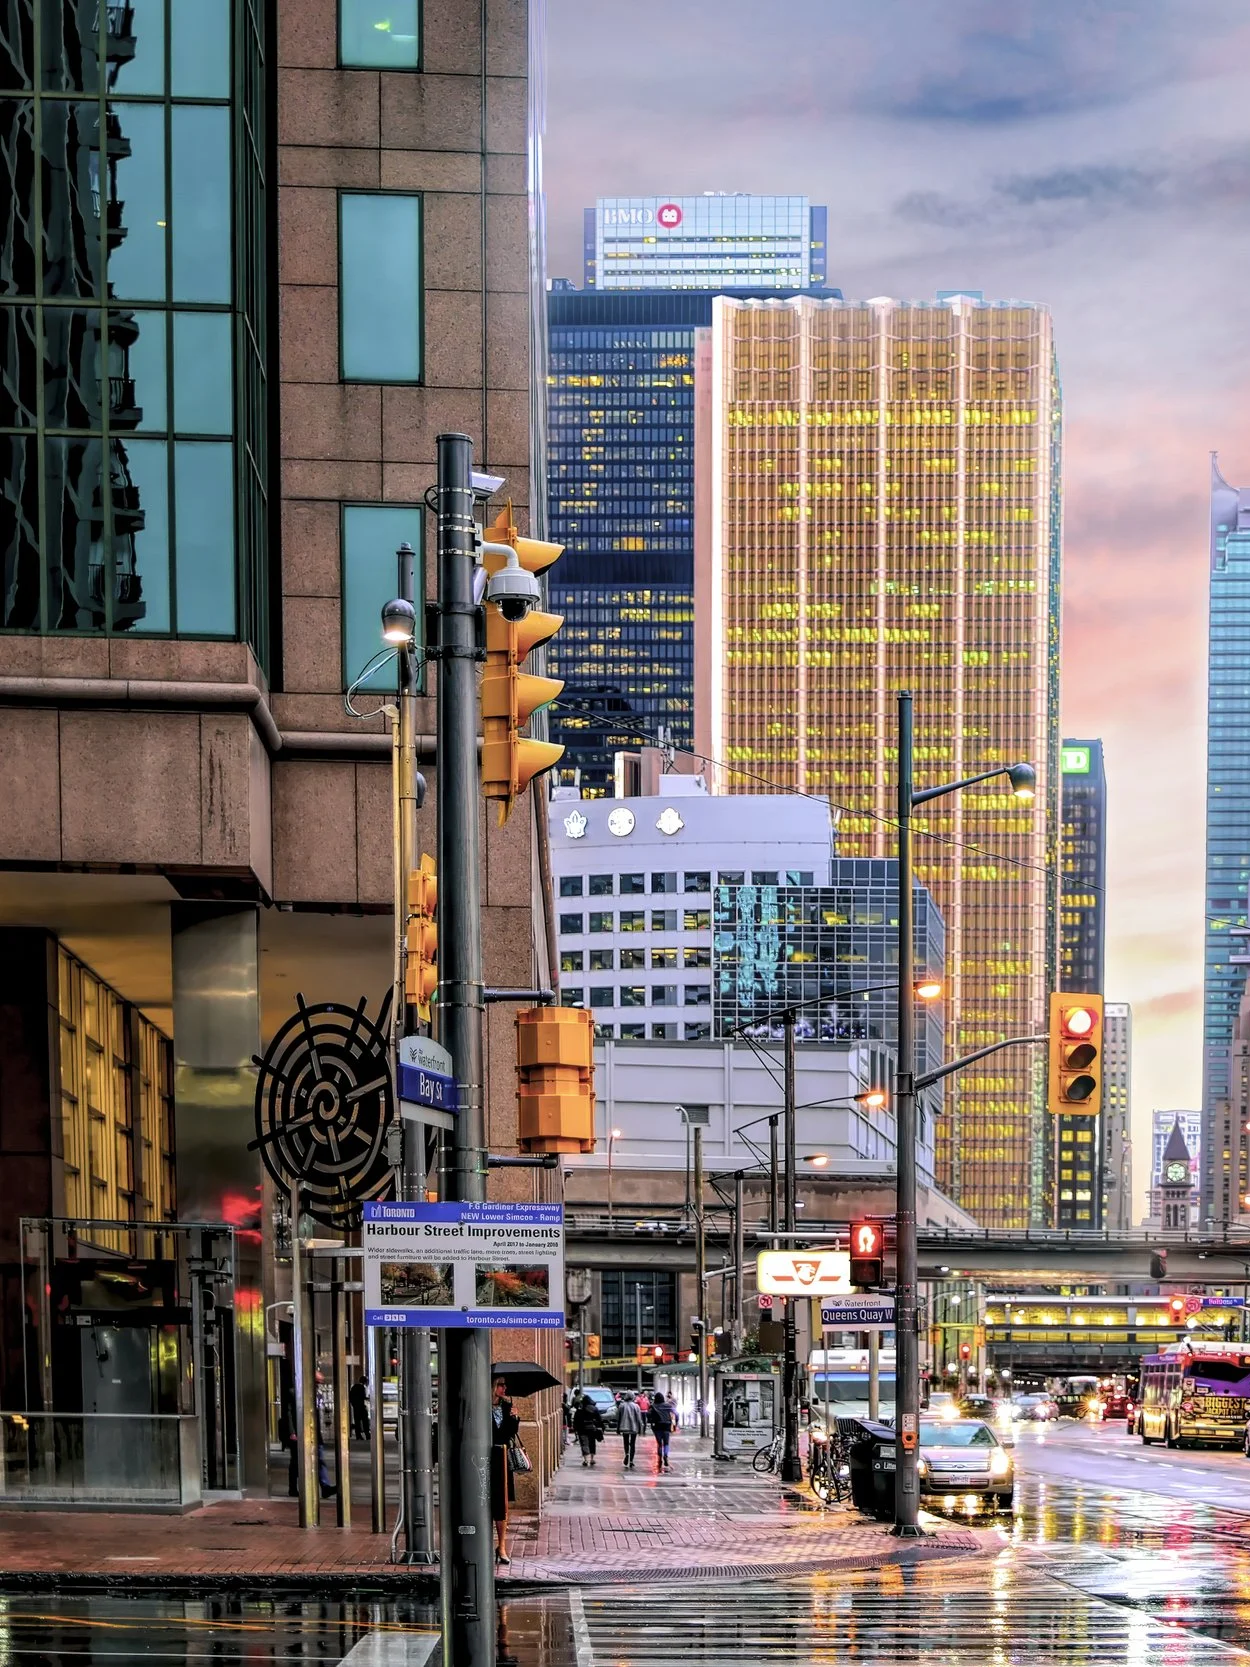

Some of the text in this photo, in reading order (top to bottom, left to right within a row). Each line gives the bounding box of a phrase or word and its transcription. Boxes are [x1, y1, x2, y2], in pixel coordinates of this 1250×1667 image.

[603, 208, 654, 225] BMO
[1062, 751, 1087, 769] TD
[420, 1072, 443, 1104] Bay St
[382, 1205, 415, 1218] TORONTO
[515, 1203, 560, 1212] Expressway
[460, 1212, 480, 1220] NEW
[505, 1213, 534, 1221] Simcoe
[540, 1214, 561, 1222] Ramp
[367, 1223, 561, 1240] Harbour Street Improvements
[822, 1309, 894, 1322] Queens Quay W
[1205, 1396, 1247, 1409] BIGGEST
